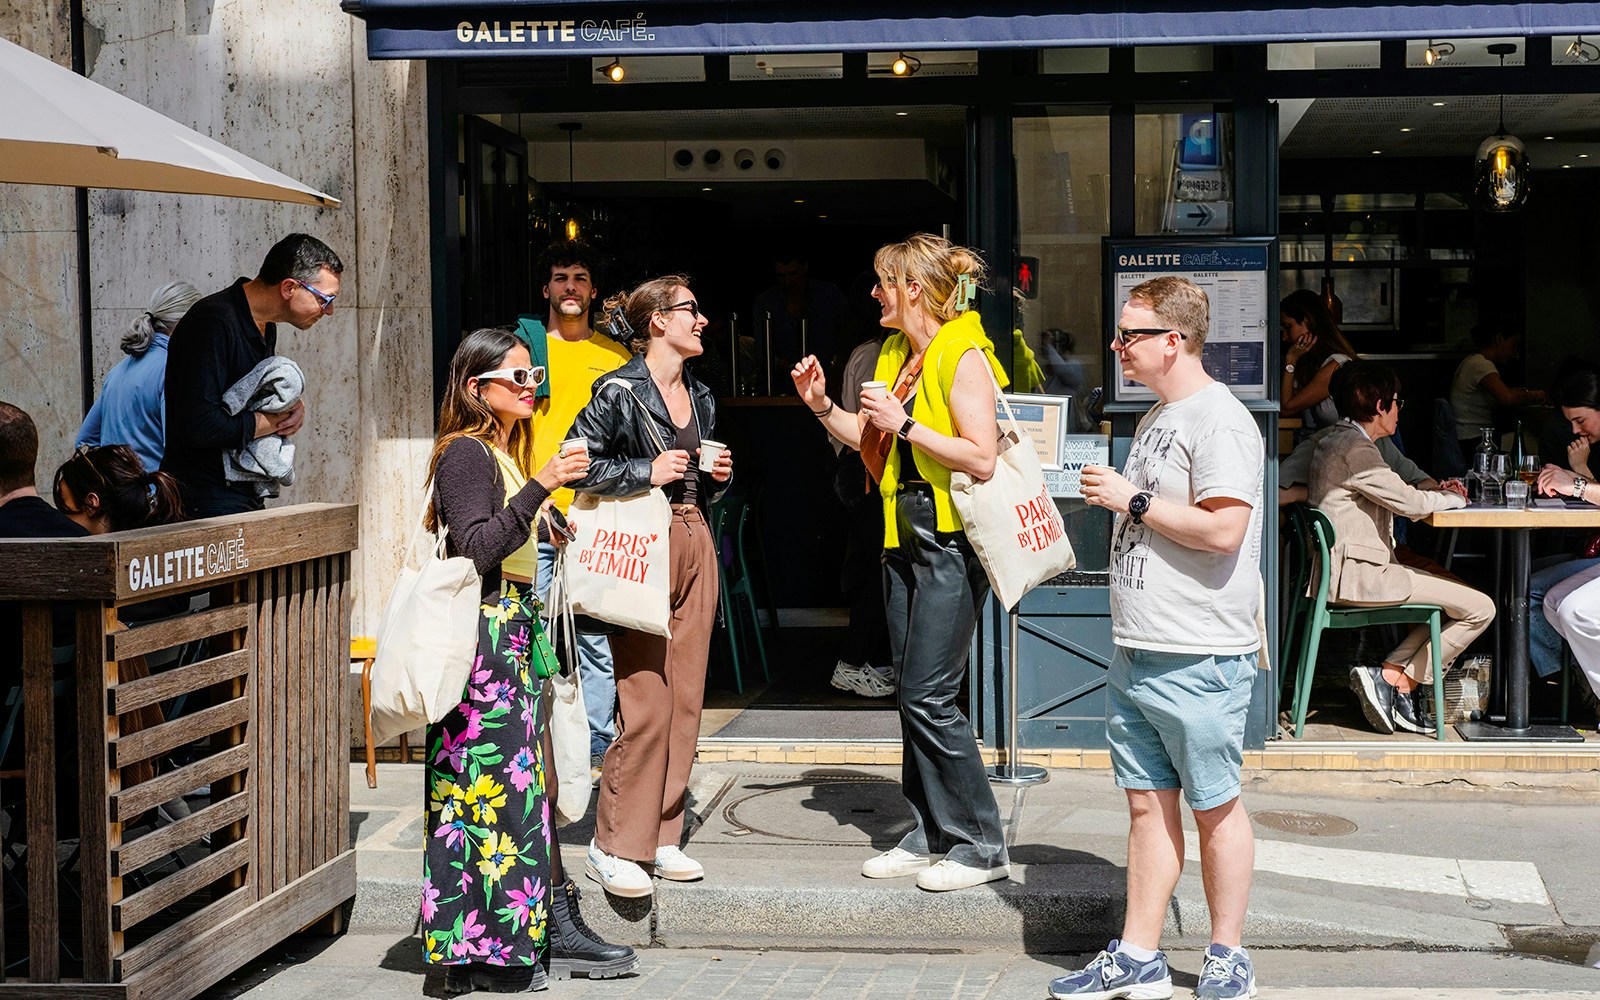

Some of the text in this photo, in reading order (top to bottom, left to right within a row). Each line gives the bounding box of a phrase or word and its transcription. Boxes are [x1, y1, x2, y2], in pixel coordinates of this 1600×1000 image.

[456, 12, 655, 42] GALETTE CAFÉ.
[1119, 254, 1180, 266] GALETTE
[1063, 463, 1098, 471] AW
[1044, 473, 1080, 481] KE AW
[1046, 484, 1080, 492] KE AW
[592, 528, 649, 558] PARIS
[1017, 530, 1032, 548] BY
[129, 528, 249, 592] GALETTE CAFÉ.
[579, 549, 650, 584] BY EMILY
